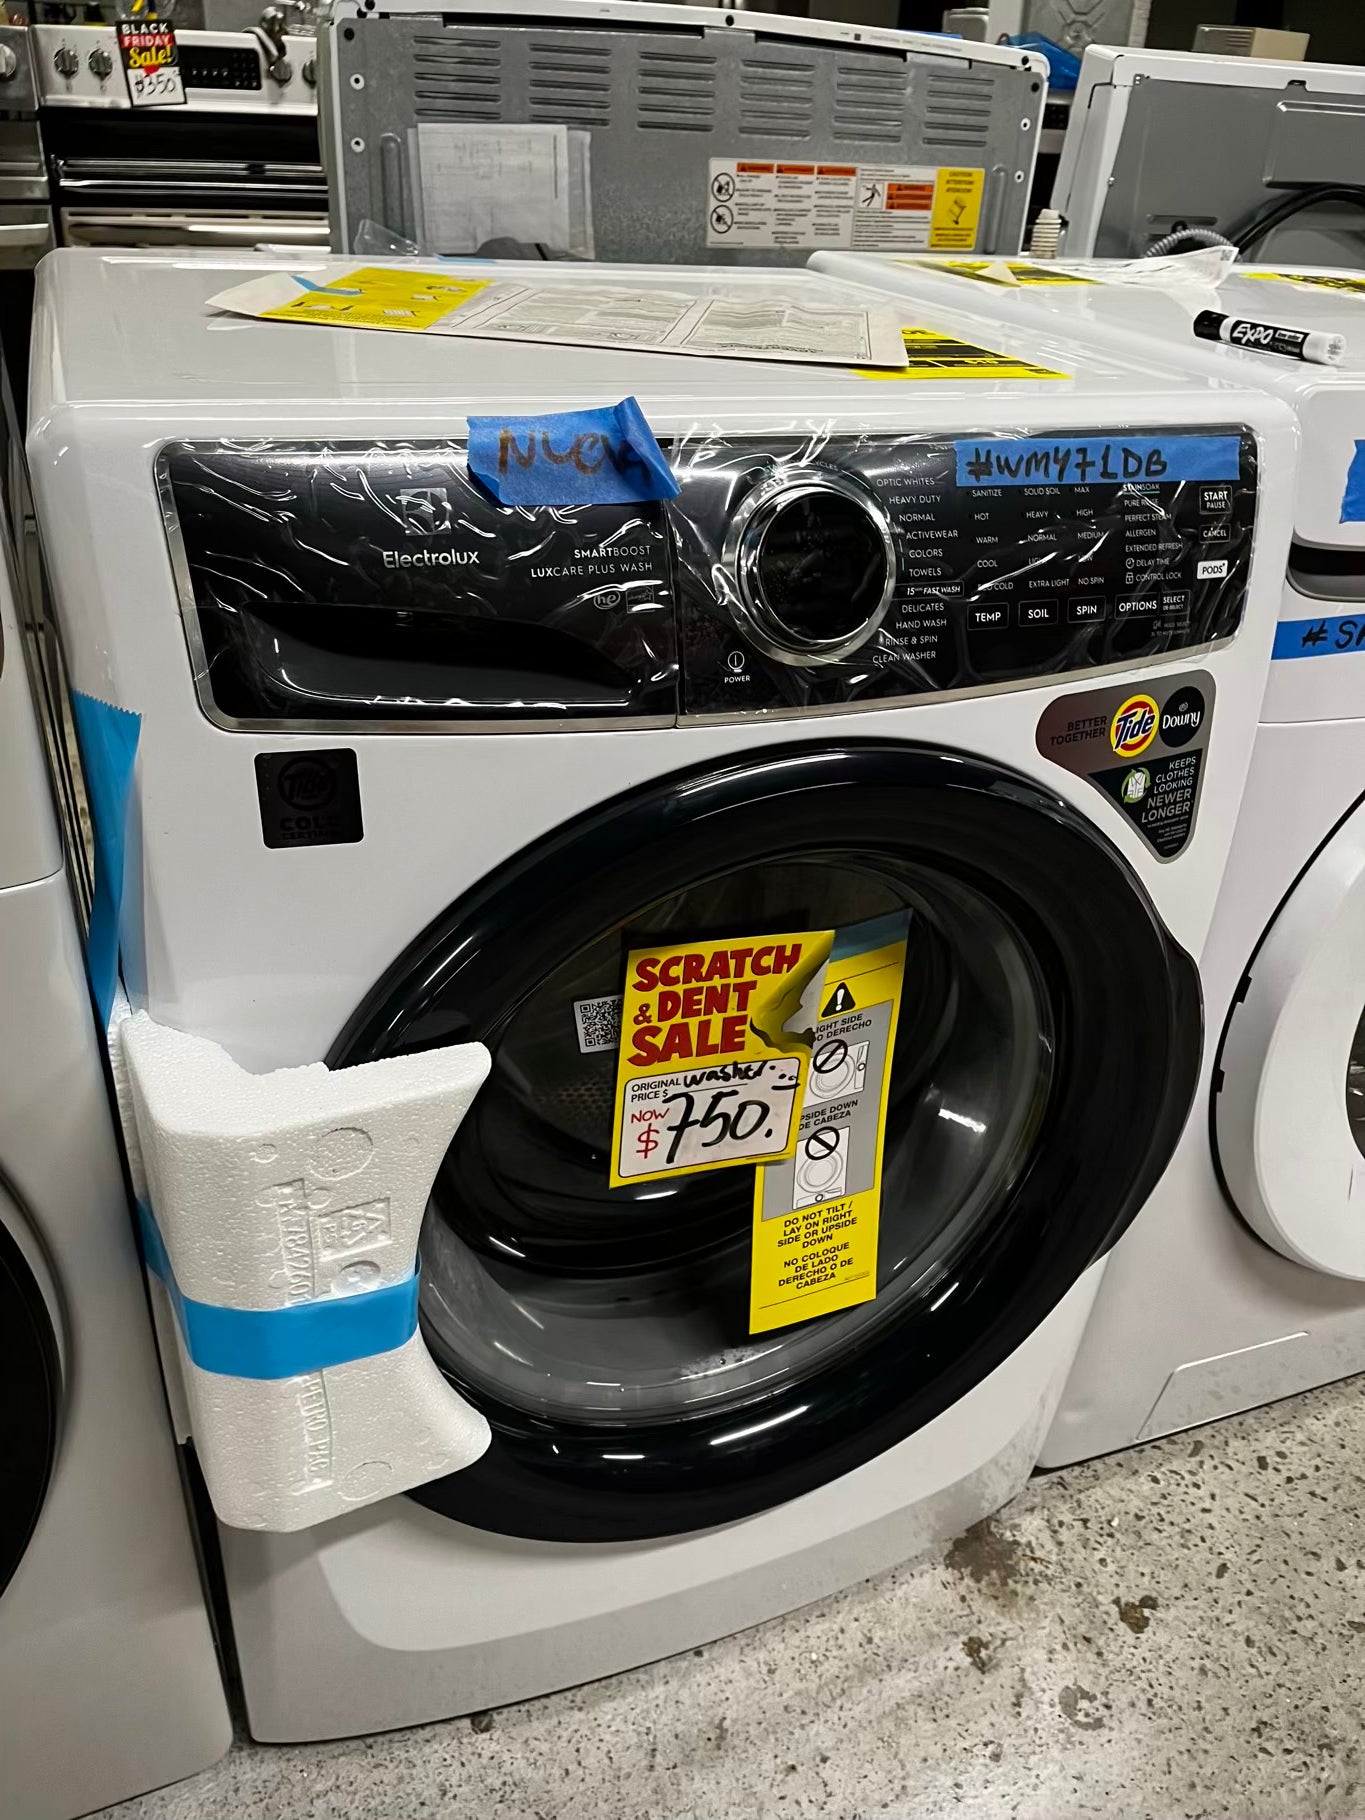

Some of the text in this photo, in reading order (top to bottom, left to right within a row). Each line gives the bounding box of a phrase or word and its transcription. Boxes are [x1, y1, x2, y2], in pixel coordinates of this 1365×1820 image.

[121, 22, 169, 35] BLACK
[123, 34, 171, 47] FRIDAY
[129, 44, 172, 68] Sale!
[1232, 323, 1274, 344] EXPO
[876, 477, 935, 487] OPTIC WHITES
[972, 489, 1003, 497] SANITIZE
[1024, 487, 1061, 496] SOLID SOIL
[1203, 491, 1228, 501] START
[889, 495, 941, 504] HEAVY DUTY
[1124, 499, 1140, 507] PURE
[1206, 501, 1226, 509] PAUSE
[899, 513, 936, 522] NORMAL
[1077, 508, 1094, 517] HIGH
[1124, 515, 1150, 523] PERFECT
[906, 529, 959, 539] ACTIVEWEAR
[1027, 534, 1057, 543] NORMAL
[1077, 531, 1105, 540] MEDIUM
[1125, 529, 1157, 538] ALLERGEN
[1202, 529, 1227, 538] CANCEL
[976, 536, 999, 544] WARM
[574, 545, 651, 559] SMARTBOOST
[909, 548, 943, 558] COLORS
[1125, 542, 1184, 553] EXTENDED REFRESH
[382, 548, 480, 569] Electrolux
[977, 559, 998, 567] COOL
[1136, 557, 1170, 567] DELAY TIME
[531, 562, 653, 578] LUXCARE PLUS WASH
[909, 567, 942, 577] TOWELS
[1090, 577, 1105, 585] SPIN
[1135, 571, 1182, 582] CONTROL LOCK
[994, 582, 1014, 590] COLD
[1029, 578, 1070, 589] EXTRA LIGHT
[907, 585, 961, 596] 15 FAST WASH
[1162, 595, 1185, 604] SELECT
[901, 603, 945, 613] DELICATES
[1076, 605, 1098, 616] SPIN
[1118, 600, 1157, 612] OPTIONS
[975, 612, 1002, 623] TEMP
[1027, 608, 1050, 619] SOIL
[895, 618, 947, 629] HAND WASH
[885, 635, 938, 646] RINSE & SPIN
[872, 651, 936, 663] CLEAN WASHER
[724, 675, 751, 684] POWER
[1067, 715, 1107, 732] BETTER
[1162, 710, 1201, 730] Downy
[1112, 706, 1156, 751] Tide
[1050, 727, 1106, 746] TOGETHER
[1169, 756, 1197, 770] KEEPS
[1156, 766, 1195, 784] CLOTHES
[1154, 777, 1193, 794] LOOKING
[1147, 788, 1192, 809] NEWER
[1141, 801, 1191, 823] LONGER
[632, 943, 802, 992] SCRATCH
[633, 979, 757, 1025] & DENT
[814, 1013, 863, 1036] IGHT SIDE
[826, 1019, 872, 1039] DERECHO
[627, 1014, 748, 1067] SALE
[631, 1078, 681, 1093] ORIGINAL
[631, 1089, 669, 1103] PRICE $
[630, 1108, 670, 1124] NOW
[800, 1099, 858, 1122] PSIDE DOWN
[813, 1110, 851, 1126] CABEZA
[636, 1123, 660, 1160] $
[784, 1217, 799, 1228] DO
[802, 1209, 823, 1223] NOT
[826, 1203, 846, 1216] TILT
[783, 1209, 853, 1237] LAY ON RIGHT
[777, 1216, 858, 1248] SIDE OR UPSIDE
[802, 1233, 833, 1249] DOWN
[783, 1241, 850, 1268] NO COLOQUE
[794, 1254, 839, 1274] DE LADO
[778, 1258, 854, 1287] DERECHO O DE
[795, 1272, 836, 1290] CABEZA
